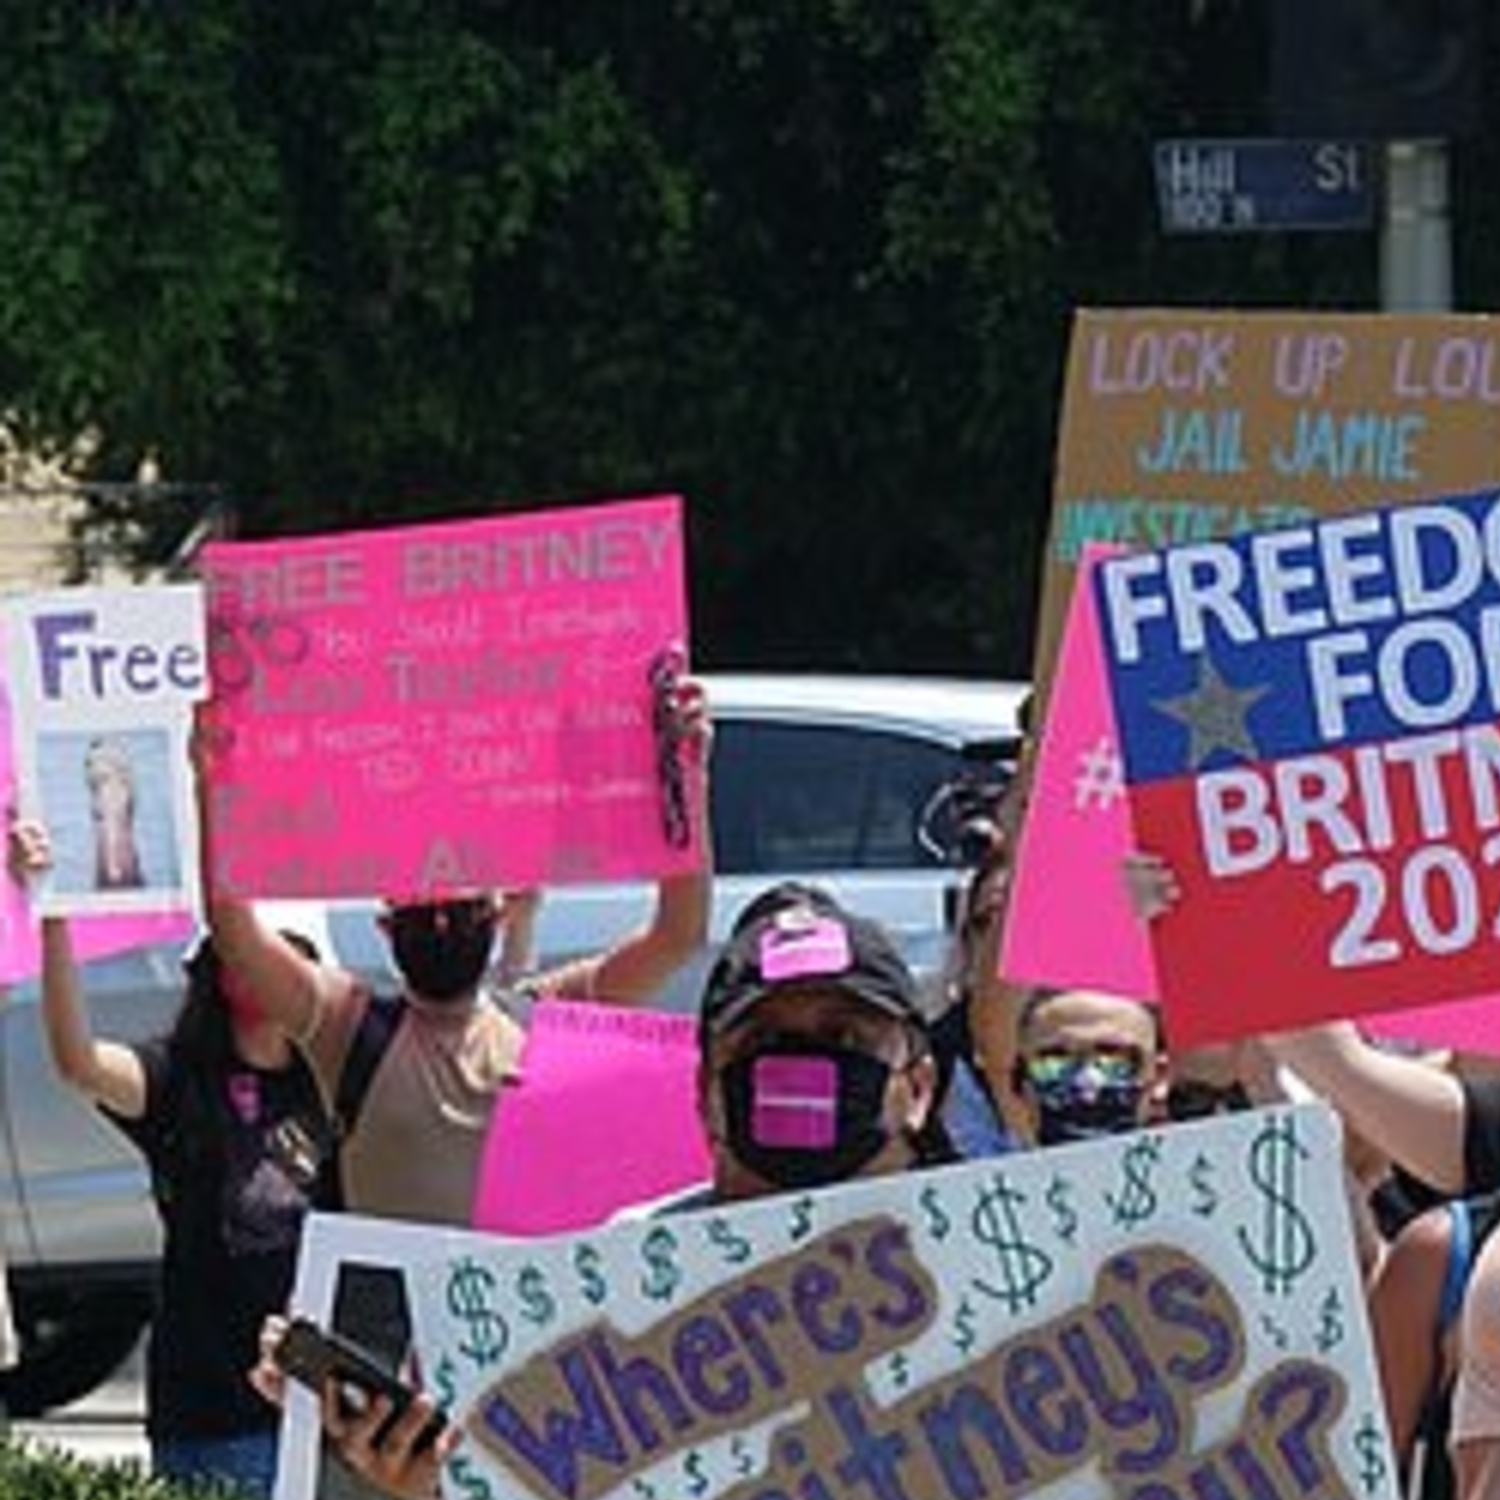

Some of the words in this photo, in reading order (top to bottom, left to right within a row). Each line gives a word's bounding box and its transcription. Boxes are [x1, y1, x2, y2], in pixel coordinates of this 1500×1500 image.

[1090, 335, 1235, 394] LOCK
[1275, 334, 1346, 396] UP
[1137, 410, 1246, 473] JAIL
[1270, 415, 1428, 481] JAMIE
[203, 556, 364, 609] FREE
[402, 520, 674, 594] BRITNEY
[33, 611, 204, 698] Free
